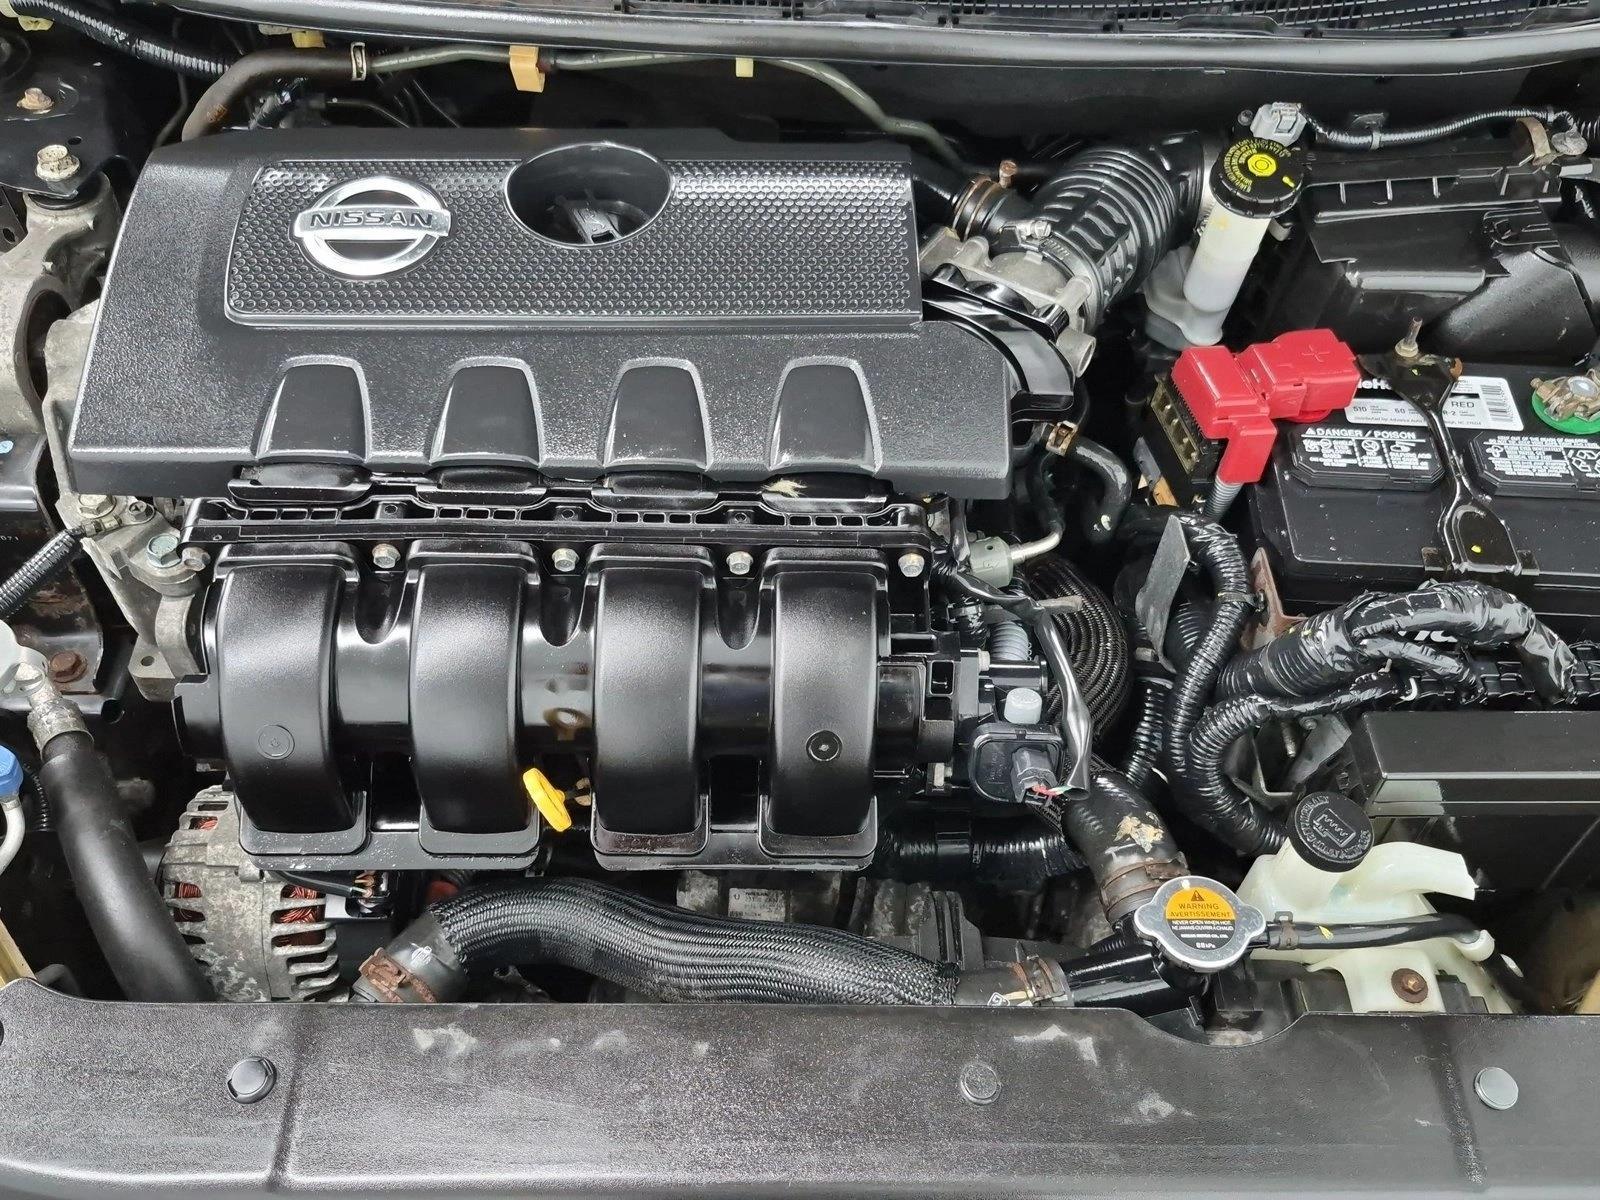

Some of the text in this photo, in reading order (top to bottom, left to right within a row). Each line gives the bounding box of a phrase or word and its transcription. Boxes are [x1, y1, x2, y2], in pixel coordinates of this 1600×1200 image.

[309, 210, 434, 228] NISSAN
[1316, 428, 1362, 437] DANGER
[1373, 431, 1416, 440] POISON
